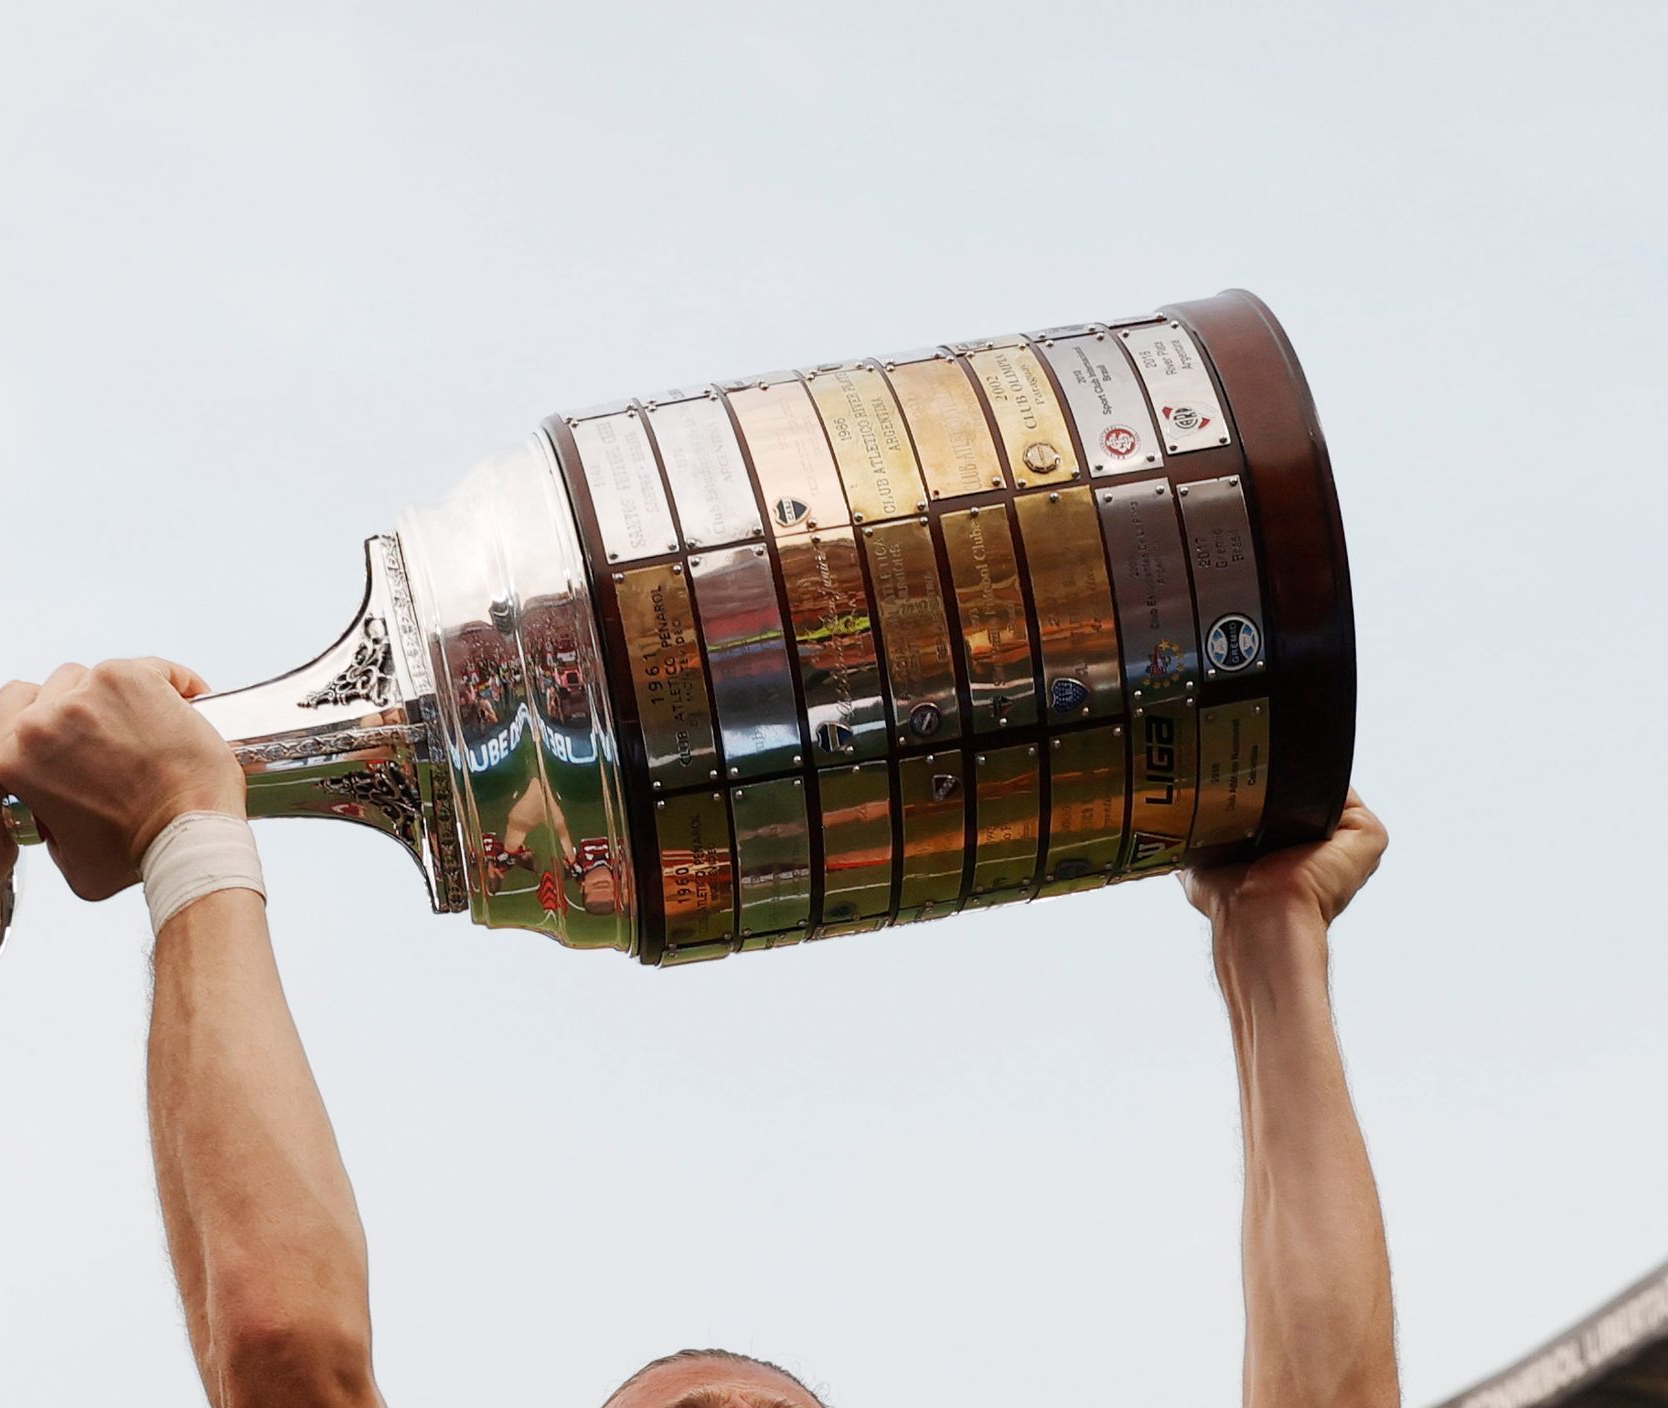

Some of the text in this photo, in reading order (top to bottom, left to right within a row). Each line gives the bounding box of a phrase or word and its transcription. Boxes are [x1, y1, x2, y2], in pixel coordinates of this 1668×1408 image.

[986, 375, 1008, 401] 2002
[833, 416, 853, 442] 1986
[870, 396, 901, 451] ARGENTINA
[1015, 395, 1038, 430] CLUB
[876, 479, 897, 515] CLUB
[969, 519, 986, 561] Clube
[642, 652, 665, 705] 1961
[664, 656, 686, 722] ATLETICO
[676, 730, 693, 767] CLUB
[675, 866, 692, 904] 1960
